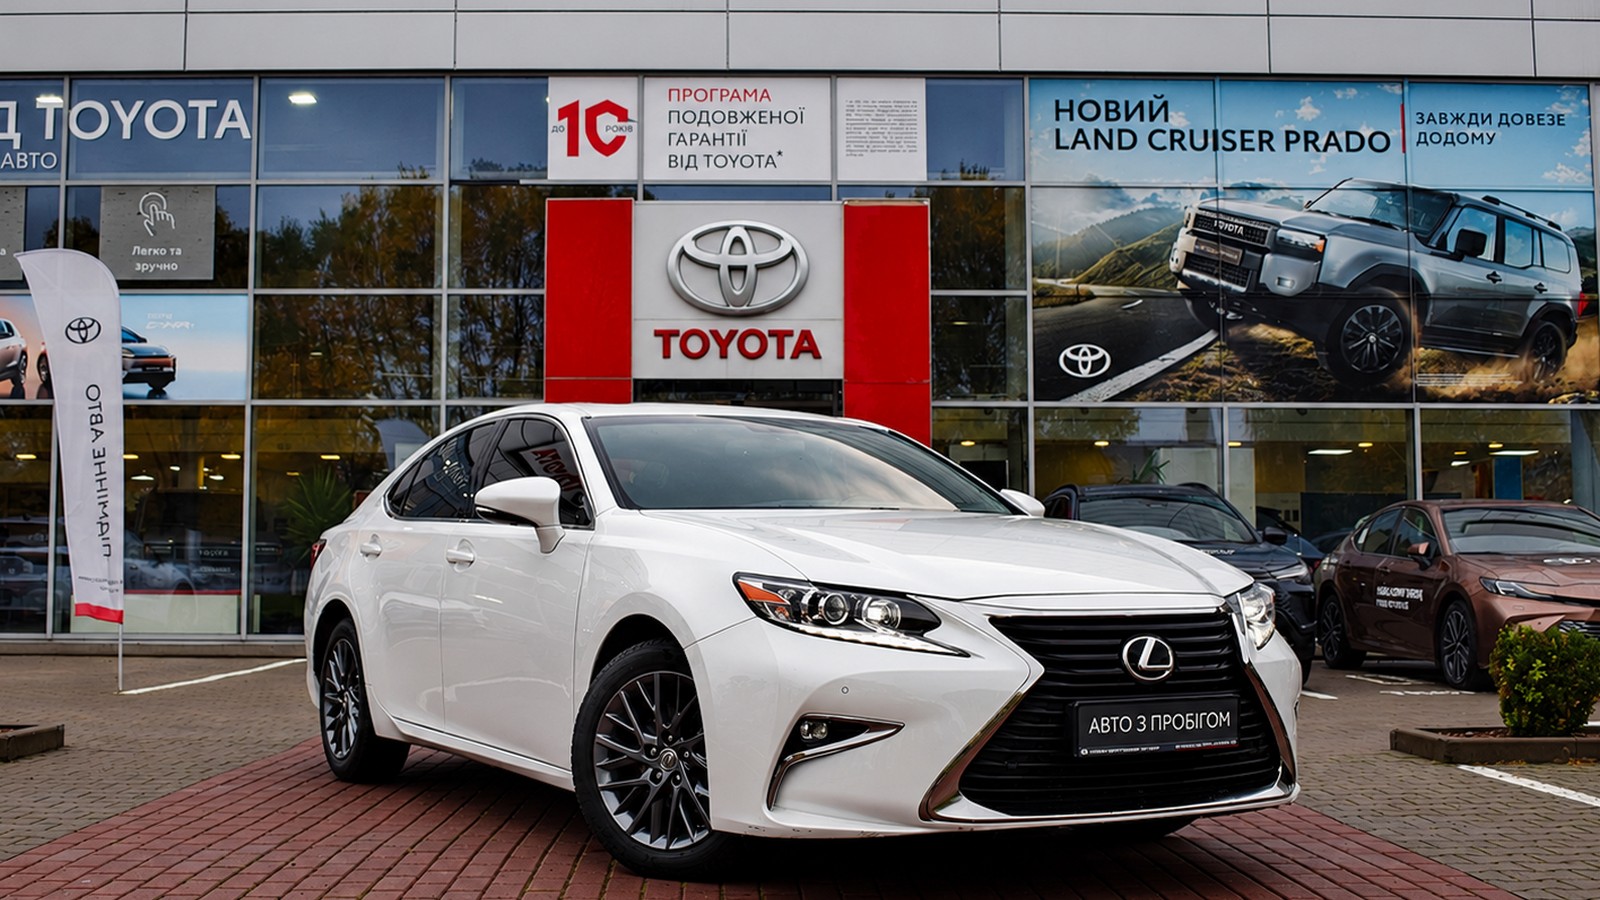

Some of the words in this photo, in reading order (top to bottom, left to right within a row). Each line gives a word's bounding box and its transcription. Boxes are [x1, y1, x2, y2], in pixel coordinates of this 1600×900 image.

[668, 88, 773, 103] ПРОГРАМА
[668, 106, 806, 127] ПОДОВЖЕНОЇ
[1055, 94, 1169, 123] НОВИЙ
[36, 99, 252, 140] TOYOTA
[1415, 112, 1493, 128] ЗАВЖДИ
[1497, 113, 1567, 127] ДОВЕЗЕ
[551, 125, 566, 133] ДО
[605, 125, 634, 133] РОКІВ
[668, 129, 748, 147] ГАРАНТІЇ
[1055, 128, 1138, 151] LAND
[1147, 128, 1276, 152] CRUISER
[1284, 130, 1392, 154] PRADO
[1416, 131, 1497, 147] ДОДОМУ
[0, 152, 58, 169] АВТО
[668, 154, 699, 171] ВІД
[132, 246, 167, 257] Легко
[170, 247, 182, 256] та
[135, 262, 179, 272] зручно
[653, 328, 822, 361] TOYOTA
[1088, 716, 1133, 734] АВТО
[1136, 715, 1147, 732] З
[1151, 711, 1231, 731] ПРОБІГОМ
